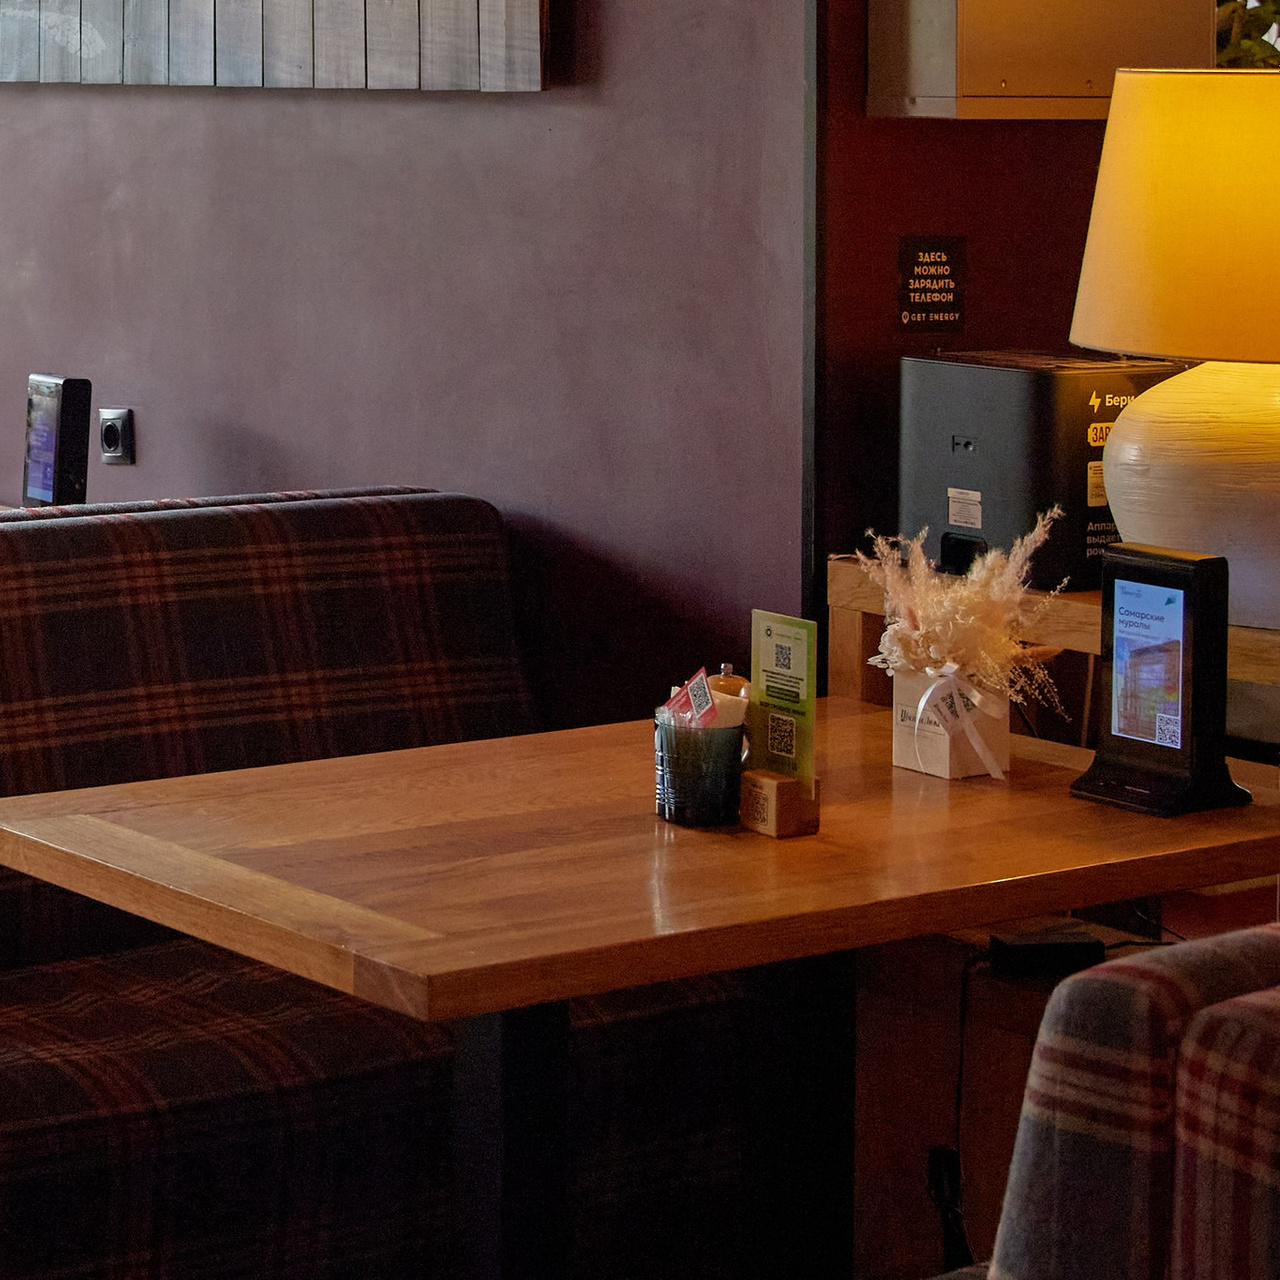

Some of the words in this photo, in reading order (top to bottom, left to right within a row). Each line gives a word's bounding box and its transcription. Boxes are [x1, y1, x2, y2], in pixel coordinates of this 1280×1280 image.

[918, 252, 947, 263] ЗДЕСЬ
[914, 266, 950, 275] МОЖНО
[908, 279, 956, 289] ЗАРЯДИТЬ
[909, 293, 953, 302] ТЕЛЕФОН
[911, 313, 926, 321] GET
[929, 313, 960, 321] ENERGY
[1118, 606, 1165, 624] Самарские
[1118, 618, 1151, 631] муралы
